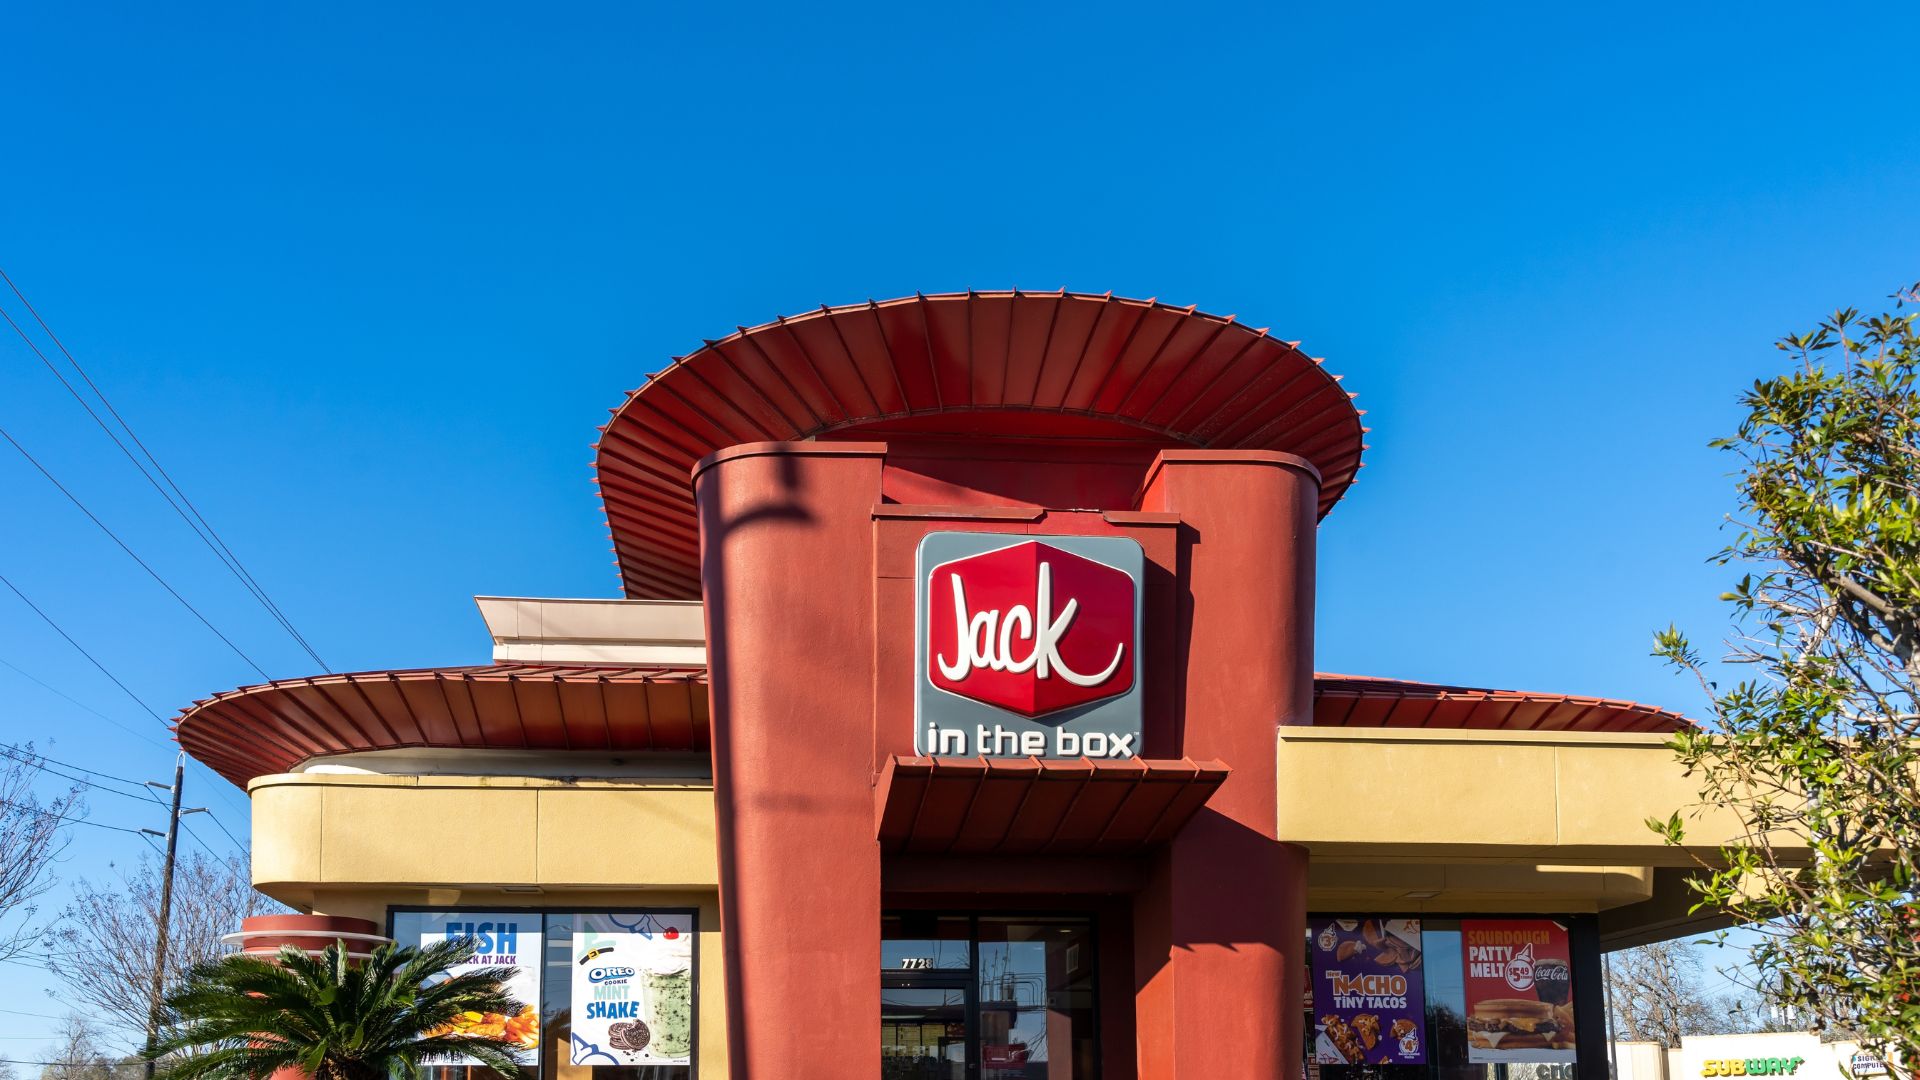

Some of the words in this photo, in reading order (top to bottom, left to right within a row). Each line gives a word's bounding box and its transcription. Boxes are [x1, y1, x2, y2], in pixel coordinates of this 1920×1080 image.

[937, 561, 1124, 688] Jack
[928, 721, 966, 754] in
[977, 724, 1046, 756] the
[1056, 726, 1134, 758] box
[446, 922, 518, 955] FISH
[1467, 930, 1550, 945] SOURDOUGH
[481, 955, 493, 965] AT
[494, 955, 517, 965] JACK
[1469, 946, 1513, 961] PATTY
[902, 958, 932, 969] 7728
[1470, 963, 1505, 978] MELT
[589, 967, 635, 983] OREO
[1333, 973, 1407, 996] NACHO
[594, 985, 631, 1001] MINT
[586, 1001, 640, 1019] SHAKE
[1366, 997, 1407, 1009] TACOS
[1701, 1056, 1805, 1077] SUBWAY
